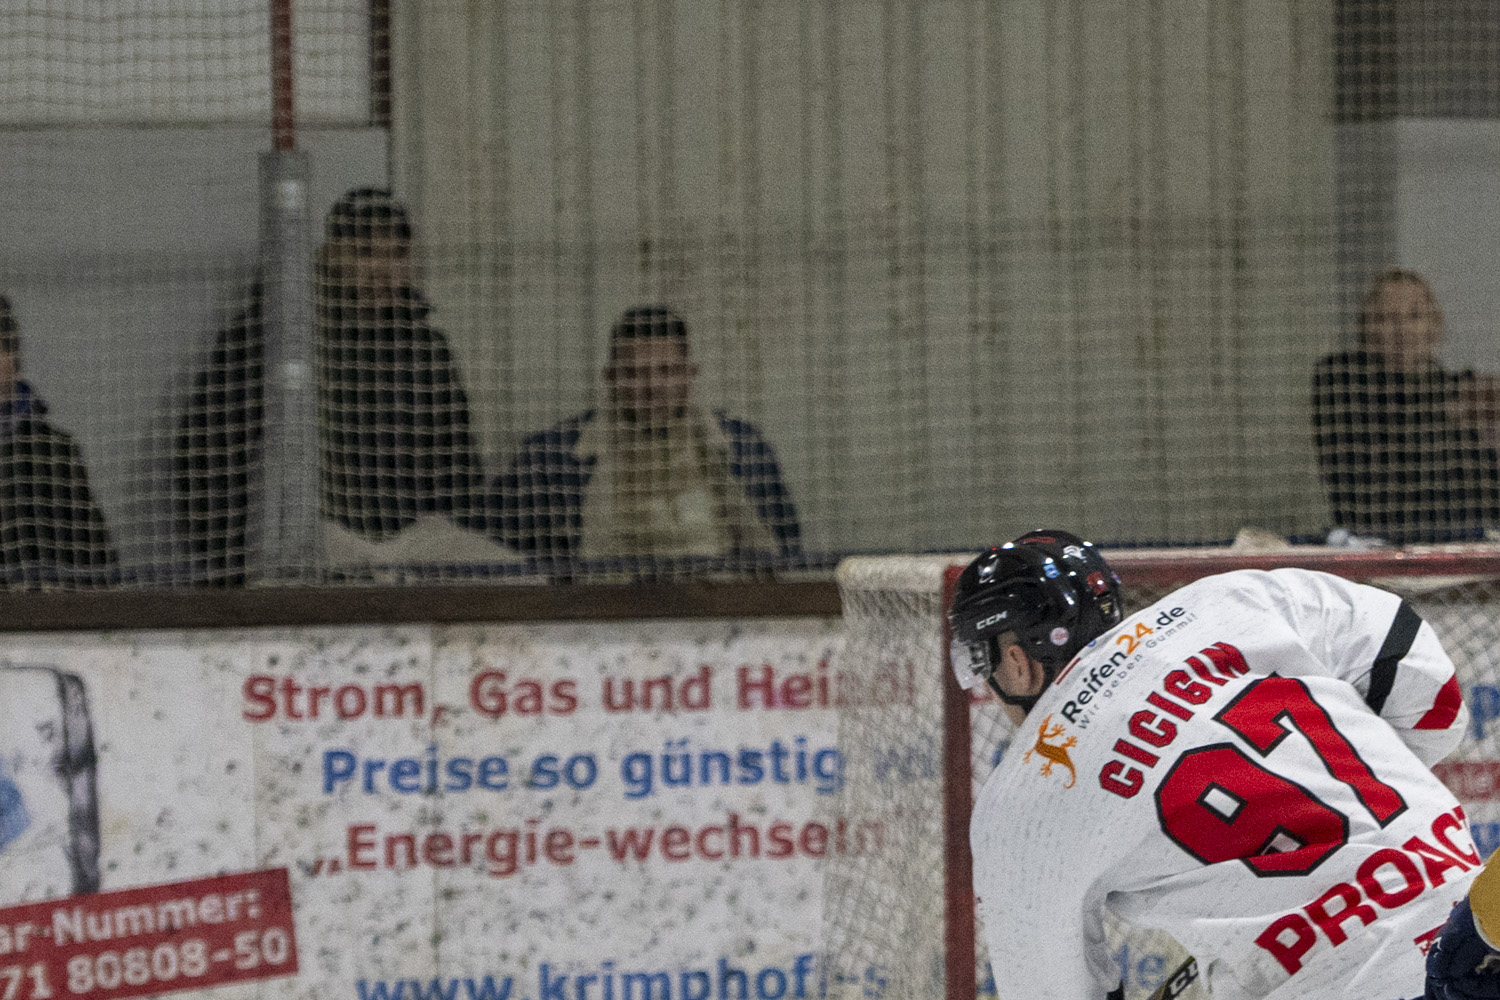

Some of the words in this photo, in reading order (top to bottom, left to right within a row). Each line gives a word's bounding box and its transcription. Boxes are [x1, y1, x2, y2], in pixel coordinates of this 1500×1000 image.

[976, 611, 1008, 630] CCM
[469, 669, 580, 718] Gas
[603, 666, 712, 713] und
[1061, 606, 1186, 724] Reifen24.de
[1078, 704, 1099, 729] Wir
[1103, 653, 1143, 698] geben
[1098, 641, 1251, 799] CICIGIN
[321, 742, 511, 795] Preise
[530, 753, 598, 791] so
[621, 736, 846, 800] günstig
[1154, 673, 1408, 878] 97
[66, 927, 290, 995] 80808-50
